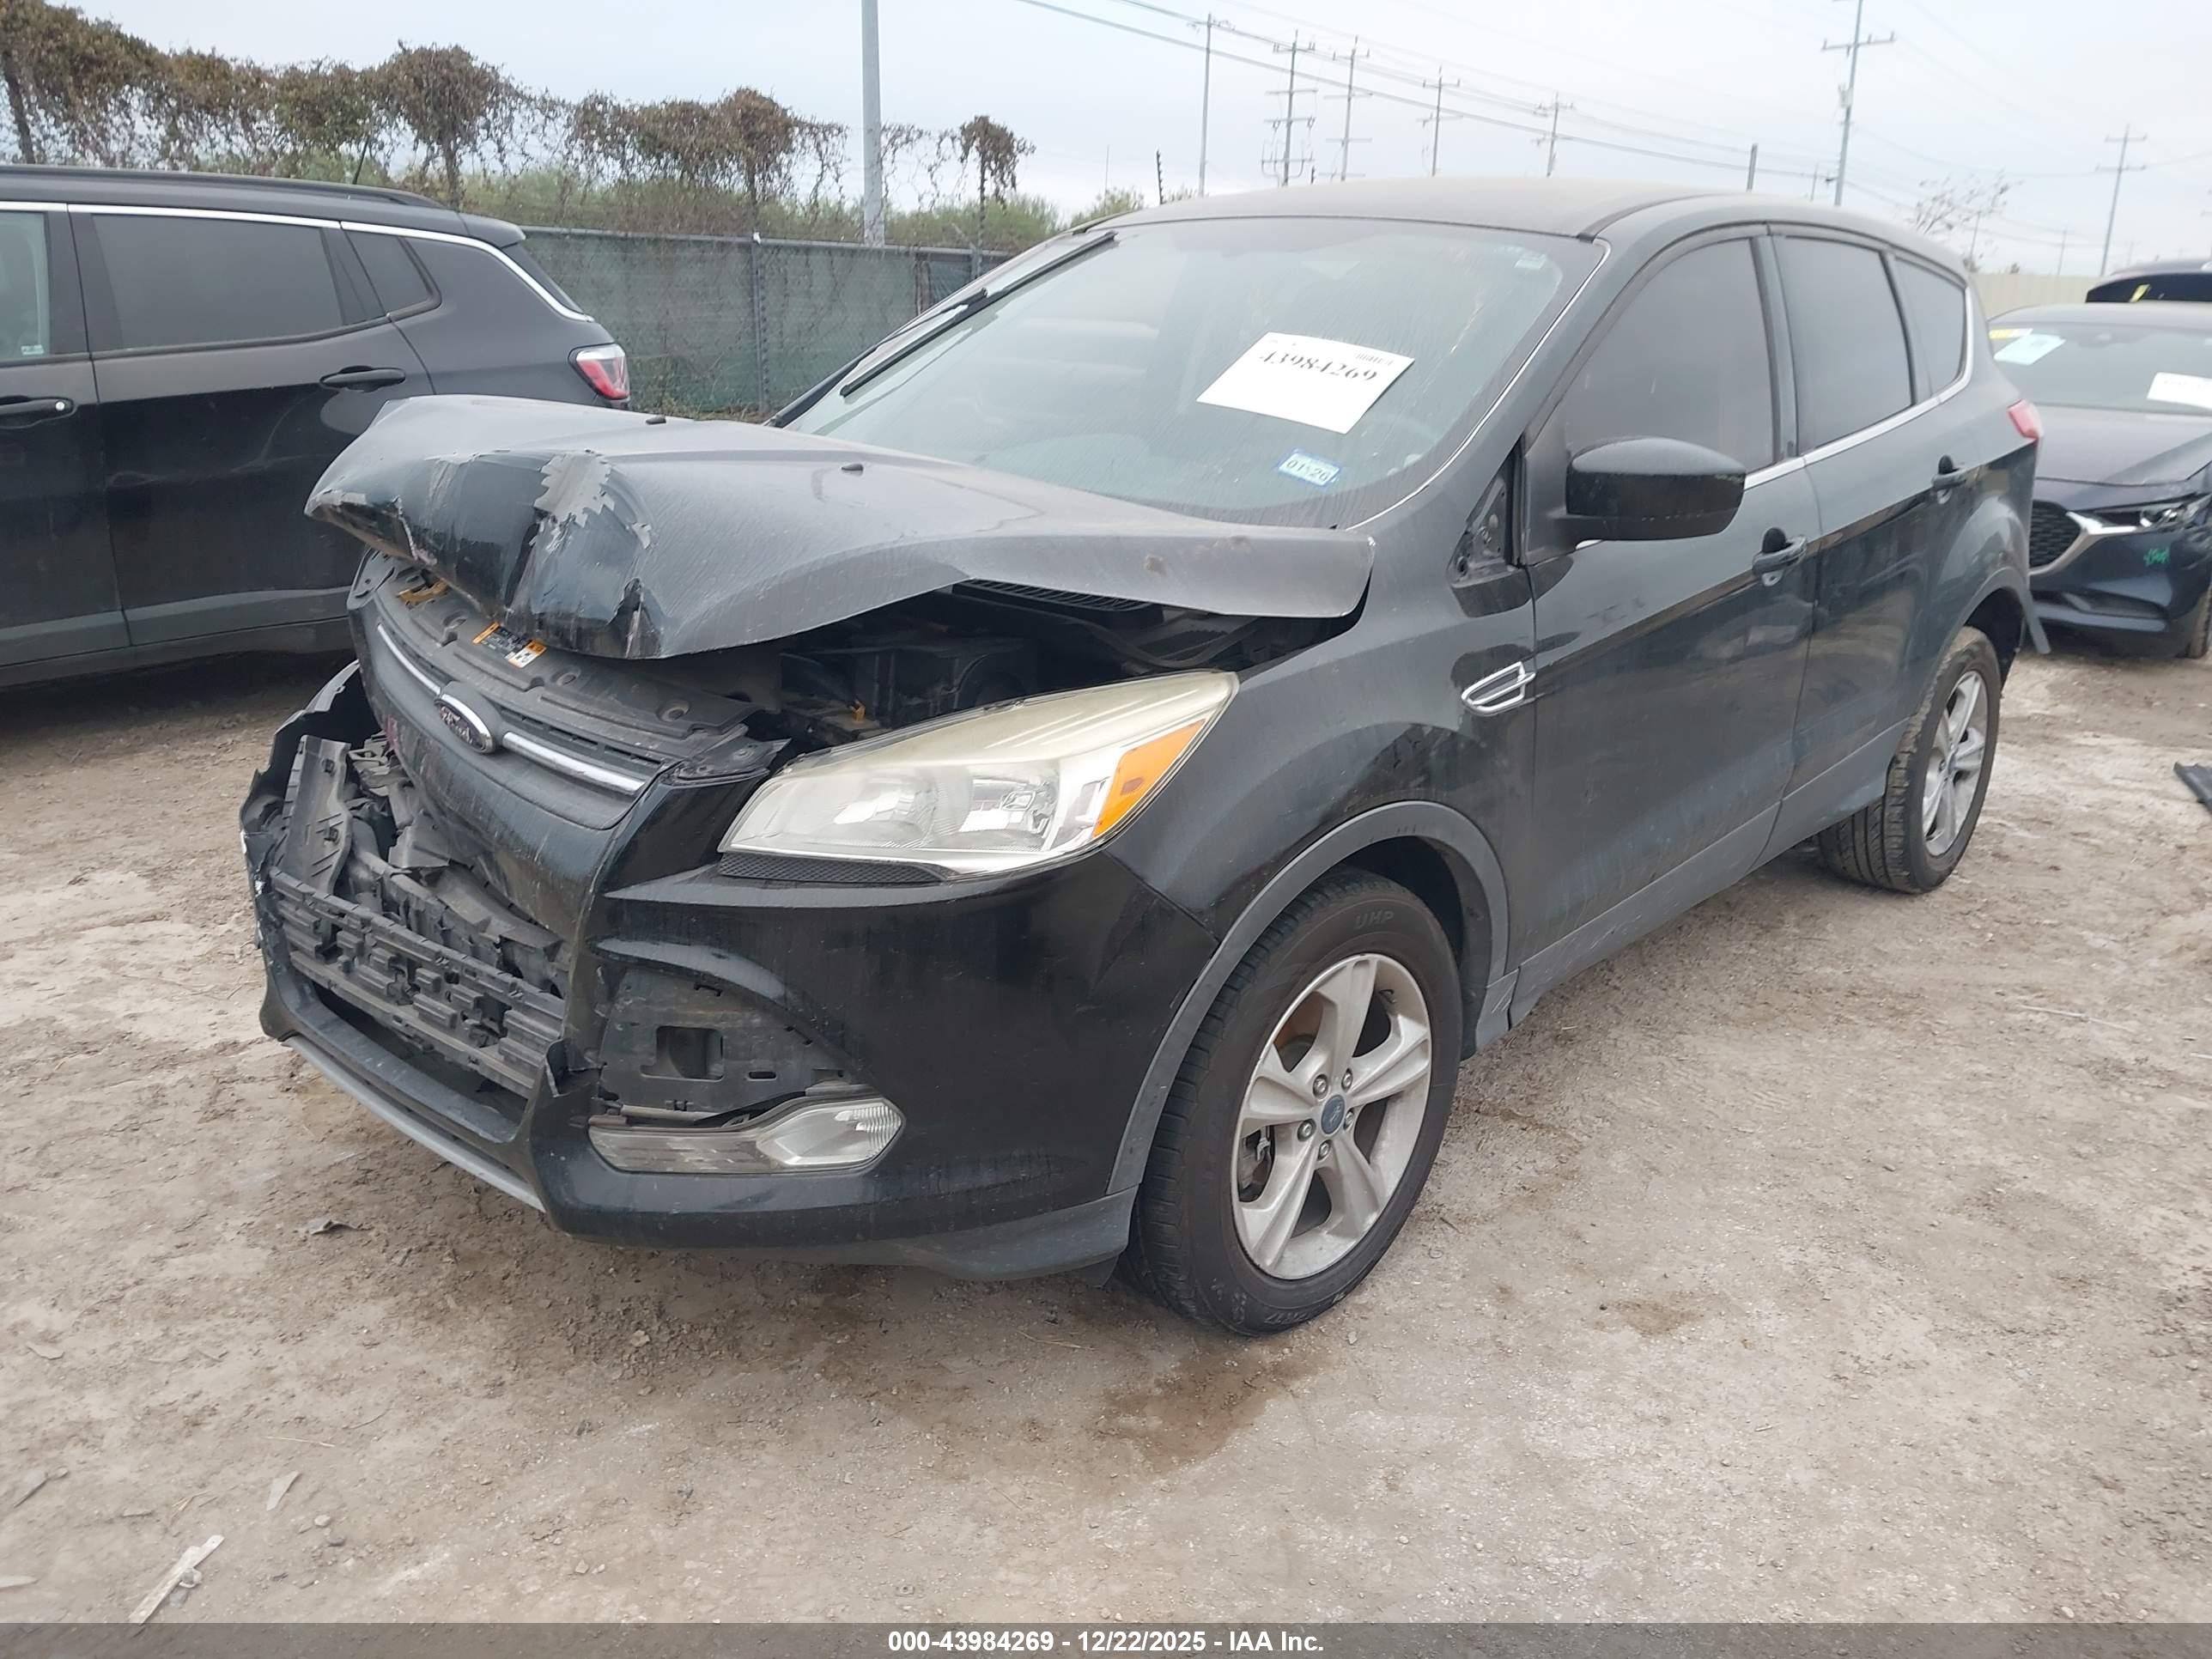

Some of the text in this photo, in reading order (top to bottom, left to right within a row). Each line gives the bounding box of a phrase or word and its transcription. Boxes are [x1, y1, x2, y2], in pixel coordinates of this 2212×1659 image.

[1258, 349, 1379, 381] 43984269
[1286, 459, 1306, 472] 01
[440, 705, 473, 744] Ford
[1352, 908, 1395, 931] UHP
